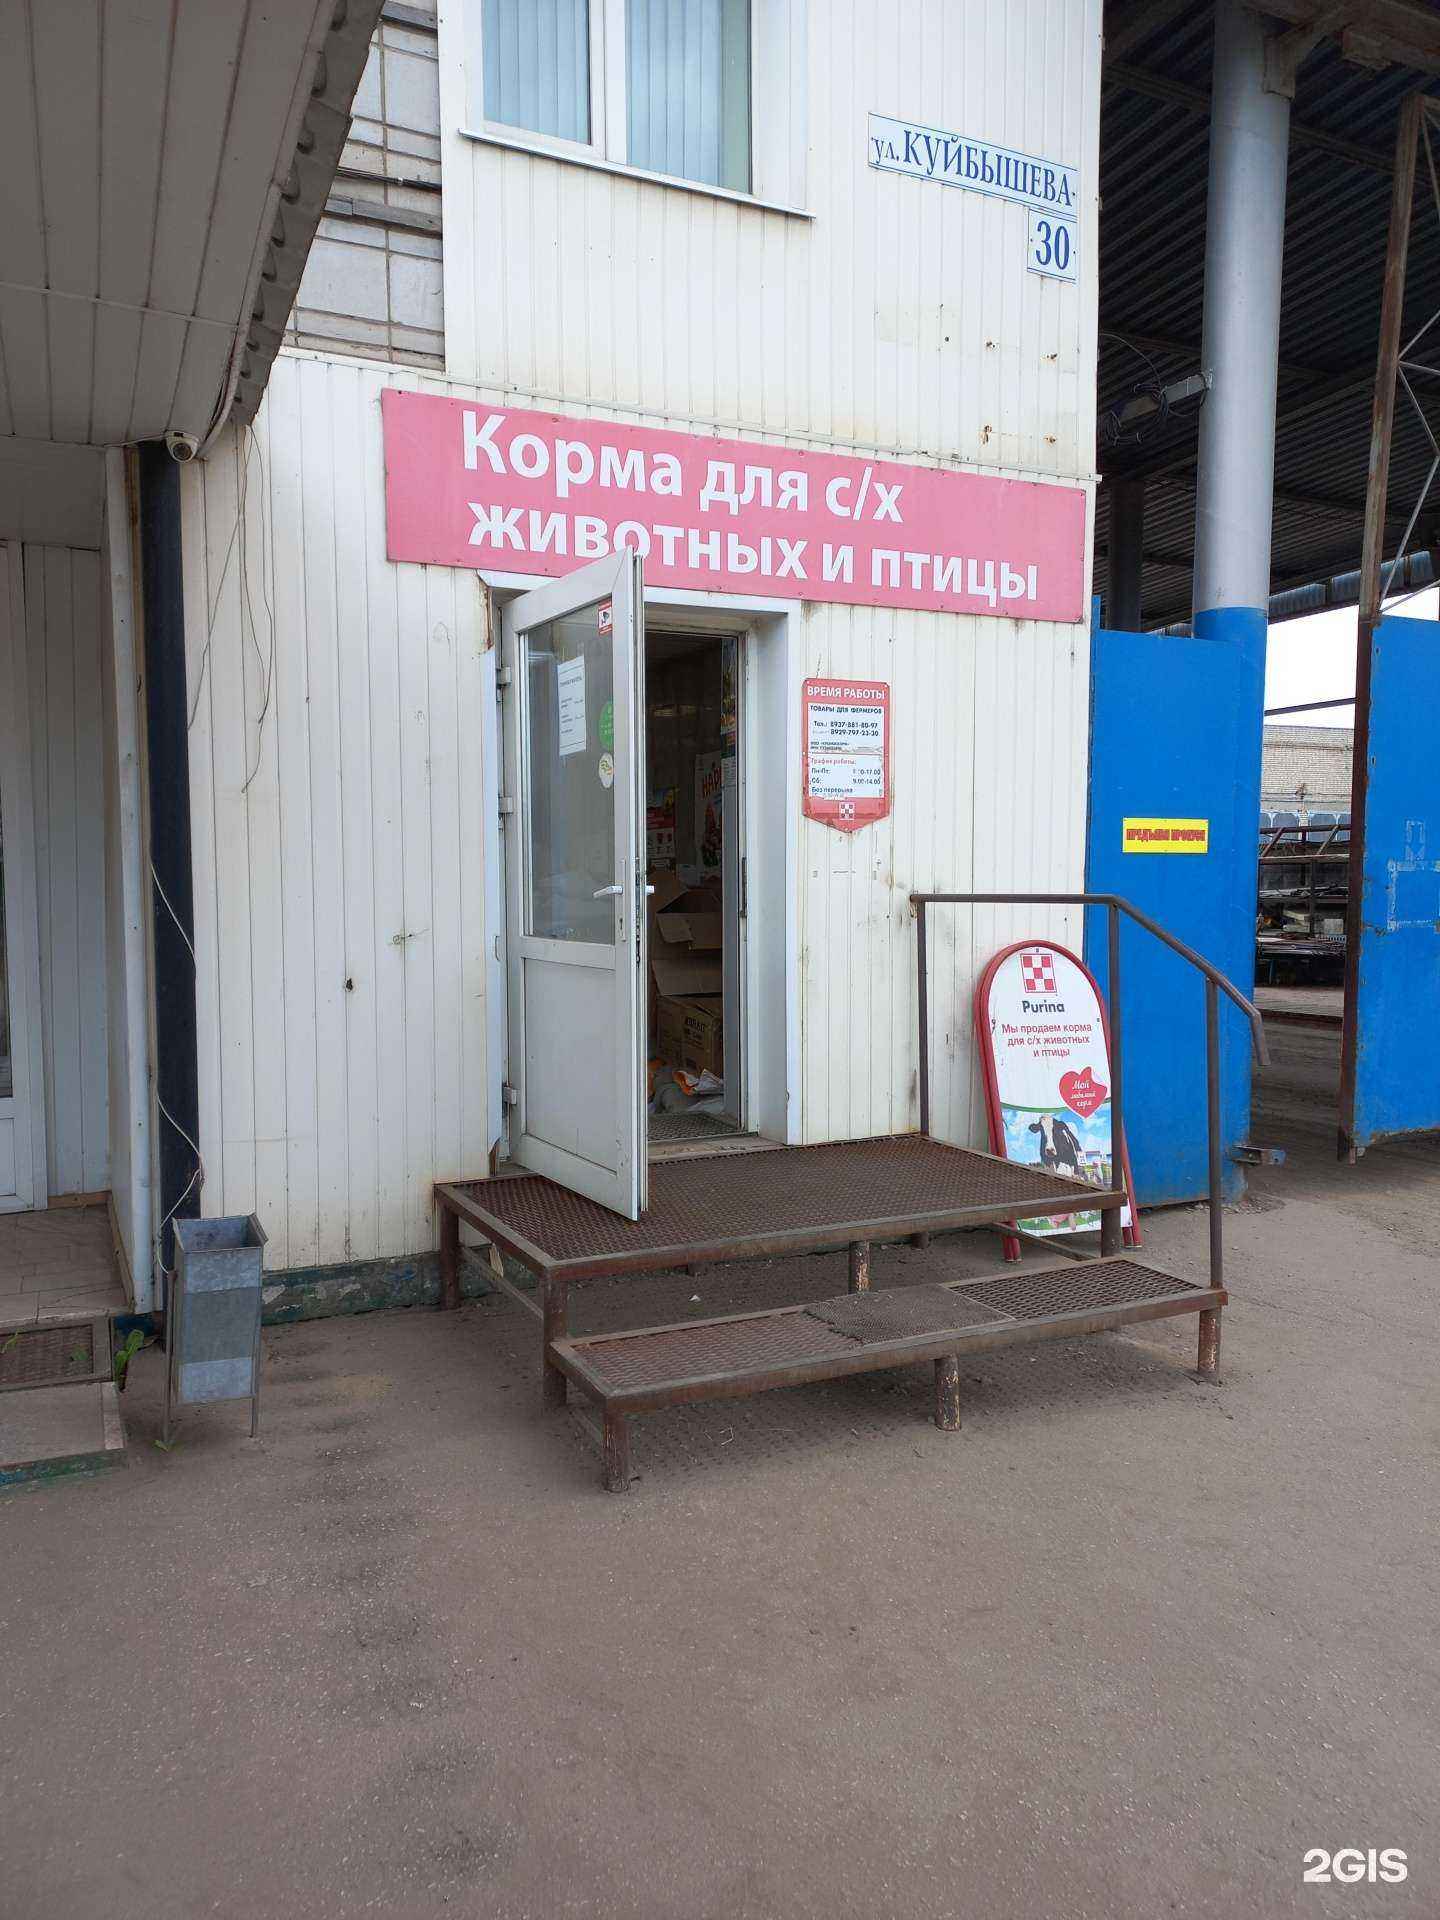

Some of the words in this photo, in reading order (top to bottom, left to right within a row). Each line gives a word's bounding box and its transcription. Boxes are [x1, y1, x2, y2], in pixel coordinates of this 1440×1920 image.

[873, 138, 899, 164] ул.
[903, 130, 1073, 206] КУЙБЫШЕВА
[1035, 220, 1070, 270] 30
[461, 410, 683, 499] Корма
[699, 459, 809, 517] для
[825, 465, 905, 523] с/х
[467, 501, 809, 580] животных
[823, 542, 854, 585] и
[871, 548, 1039, 608] птицы
[807, 686, 842, 698] ВРЕМЯ
[843, 688, 885, 699] РАБОТЫ
[810, 705, 835, 713] ТОВАРЫ
[1021, 1000, 1065, 1013] Purina
[1002, 1024, 1018, 1034] Мы
[1021, 1024, 1061, 1035] продаем
[1063, 1023, 1092, 1035] корма
[1007, 1037, 1025, 1047] для
[1026, 1036, 1041, 1046] с/х
[1043, 1036, 1090, 1045] животных
[1033, 1049, 1040, 1057] и
[1041, 1048, 1070, 1058] птицы
